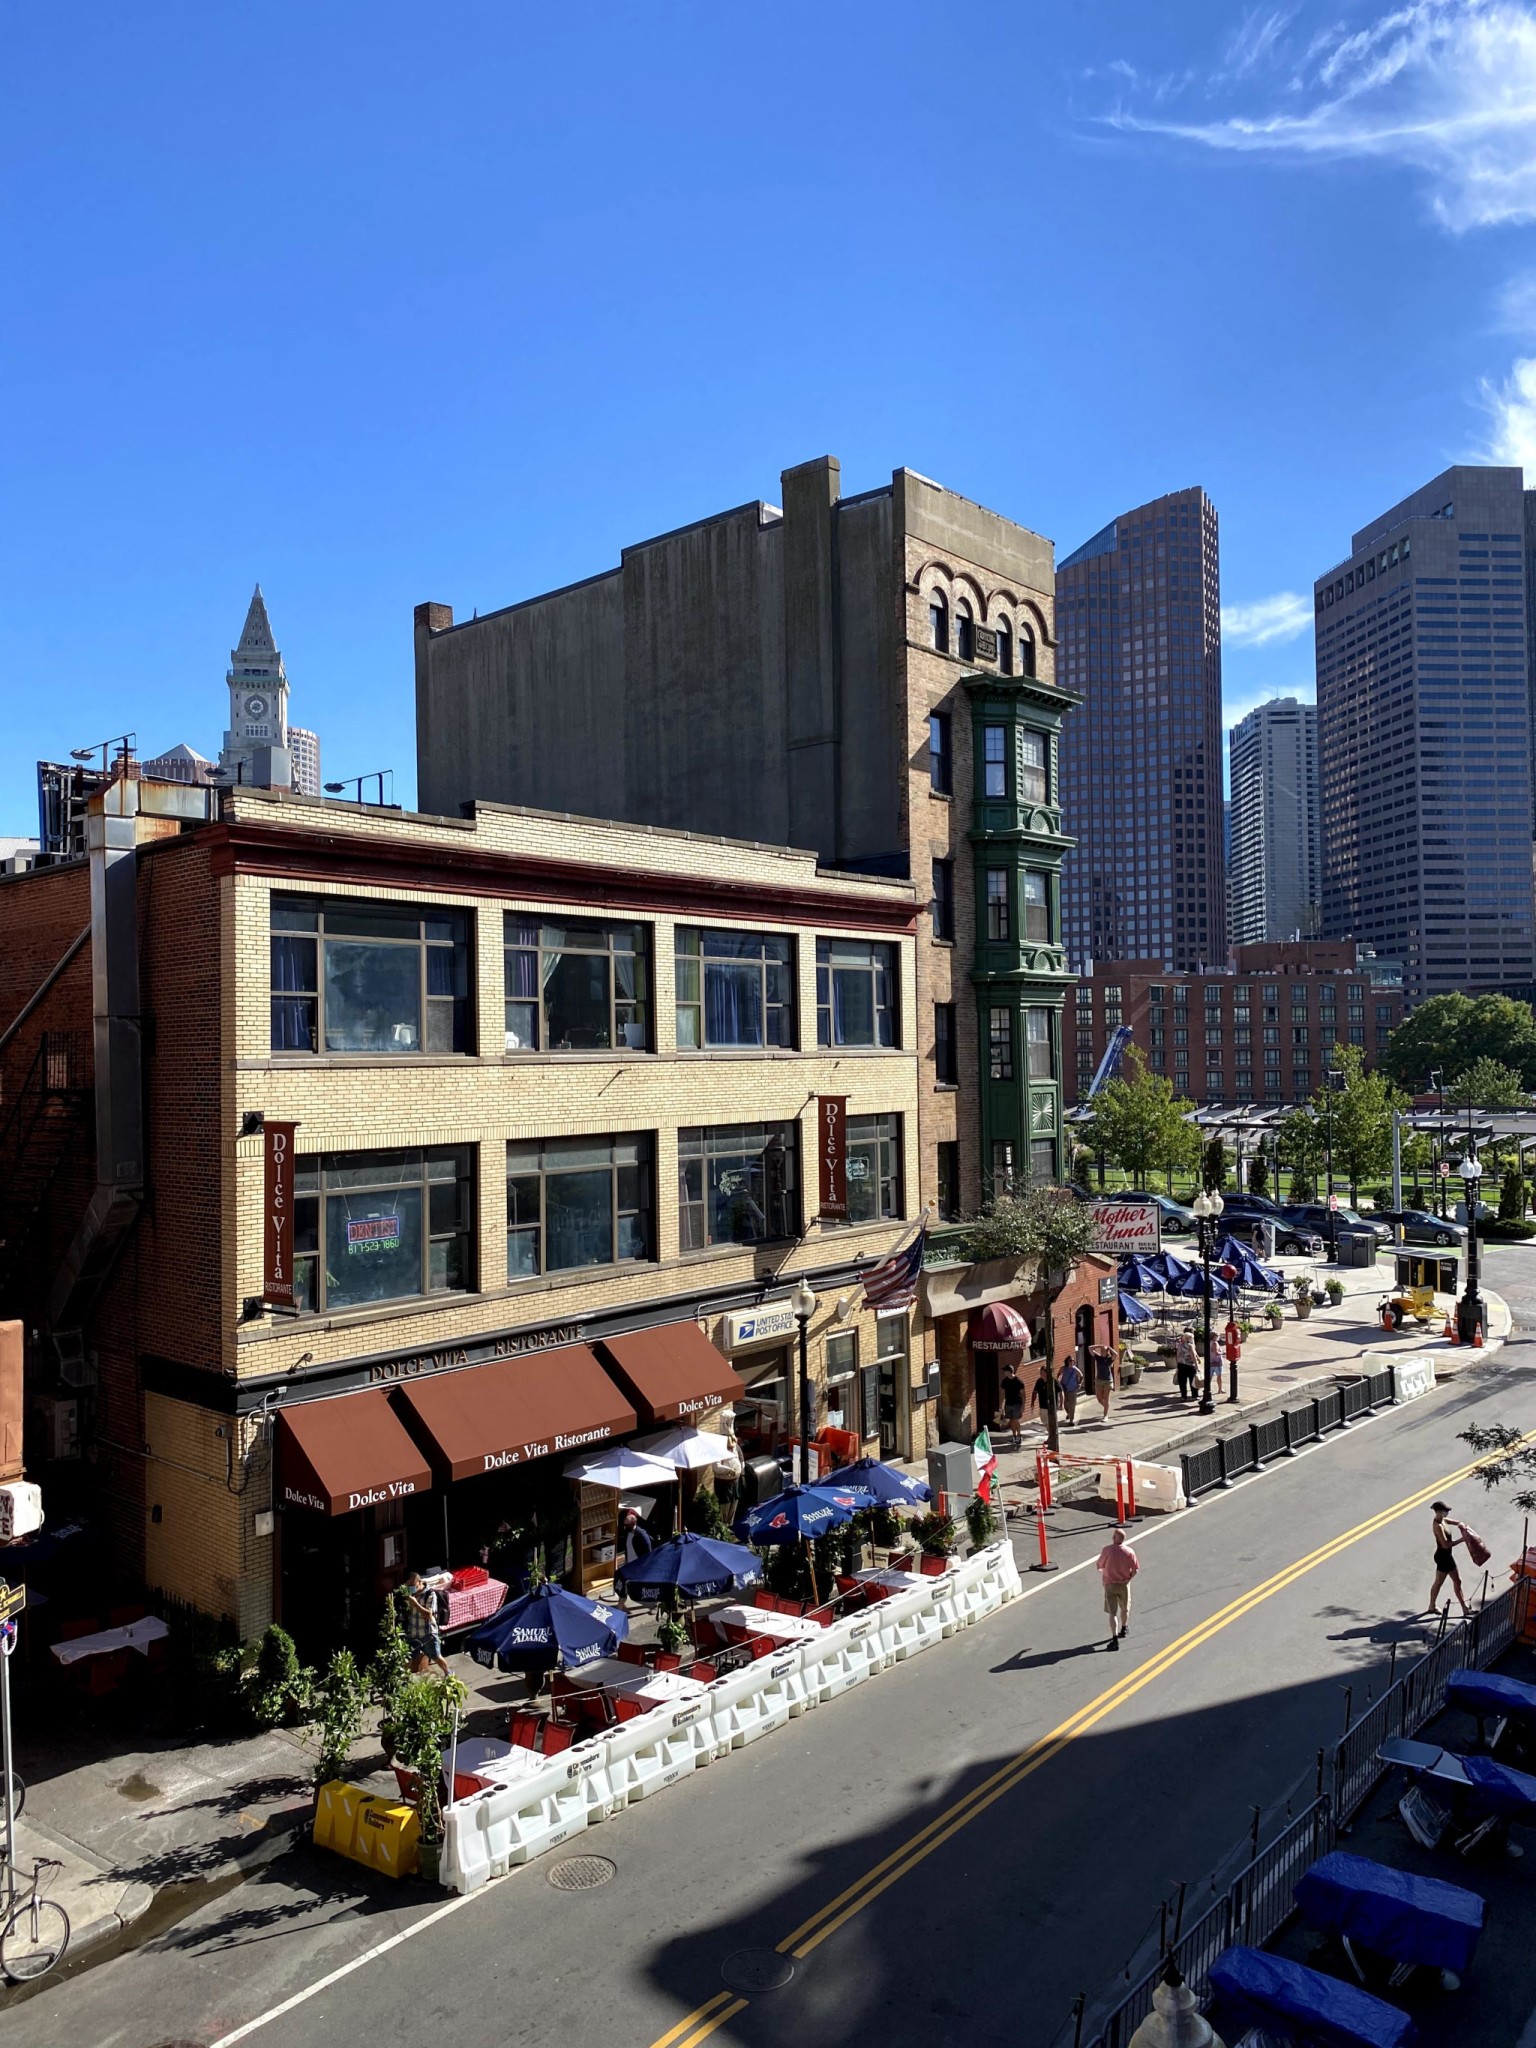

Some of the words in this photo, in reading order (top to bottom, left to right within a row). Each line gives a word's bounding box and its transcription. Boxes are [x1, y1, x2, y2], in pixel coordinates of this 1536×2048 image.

[825, 1103, 839, 1154] Dolce
[272, 1133, 287, 1208] Dolce
[825, 1158, 838, 1201] Vita
[1092, 1206, 1154, 1225] Mother
[350, 1219, 397, 1240] DENTIST
[1092, 1221, 1156, 1241] Anna's
[271, 1215, 286, 1280] Vita
[264, 1281, 292, 1296] RISTORANTE
[755, 1324, 772, 1337] POST
[772, 1320, 794, 1332] OFFICE
[756, 1314, 781, 1327] UNITED
[781, 1311, 794, 1322] STAT
[369, 1356, 427, 1383] DOLCE
[431, 1349, 470, 1369] VITA
[494, 1324, 586, 1357] RISTORANTE
[678, 1400, 704, 1415] Dolce
[704, 1394, 723, 1408] Vita
[483, 1452, 520, 1471] Dolce
[523, 1443, 549, 1459] Vita
[554, 1425, 611, 1450] Ristorante
[285, 1487, 308, 1506] Dolce
[307, 1494, 325, 1511] Vita
[348, 1488, 387, 1510] Dolce
[388, 1481, 416, 1498] Vita
[801, 1506, 834, 1521] SAMUEL
[512, 1626, 553, 1638] SAMUEL
[512, 1633, 549, 1645] ADAMS
[575, 1642, 601, 1658] SAMUEL
[578, 1648, 601, 1663] ADAMS
